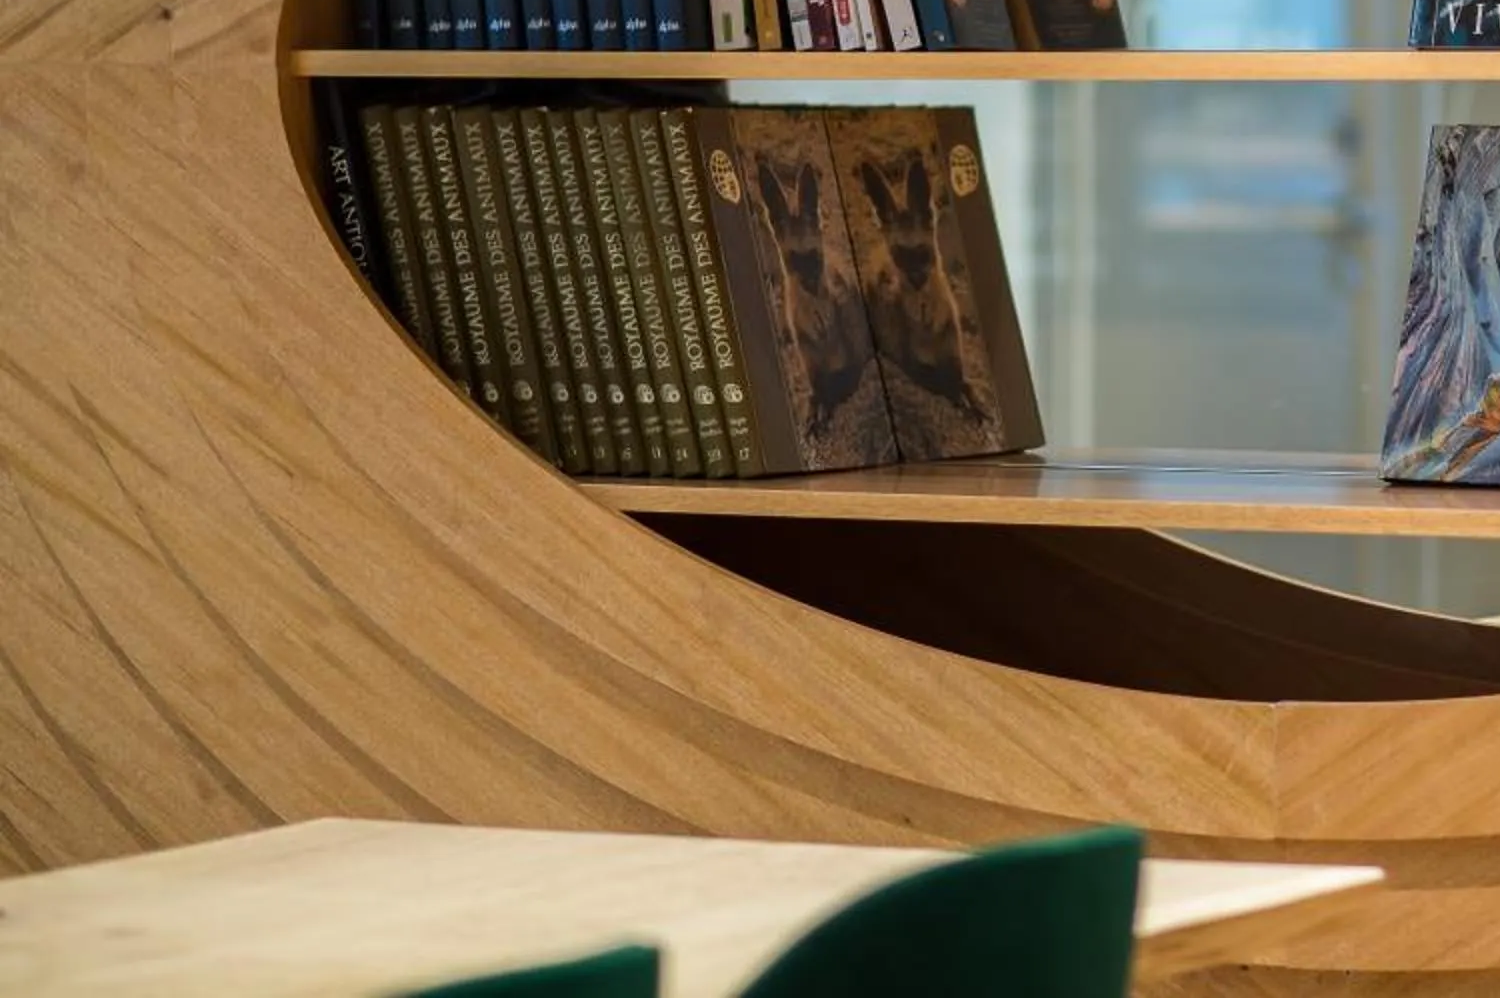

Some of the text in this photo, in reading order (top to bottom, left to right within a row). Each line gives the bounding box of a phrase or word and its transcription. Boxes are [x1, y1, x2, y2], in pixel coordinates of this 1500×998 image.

[328, 145, 351, 184] ART
[367, 122, 400, 222] ANIMAUX
[402, 122, 435, 222] ANIMAUX
[424, 228, 442, 265] DES
[431, 122, 491, 365] ROYAUME DES ANIMAUX
[465, 122, 525, 366] ROYAUME DES ANIMAUX
[498, 122, 560, 367] ROYAUME DES ANIMAUX
[528, 124, 588, 369] ROYAUME DES ANIMAUX
[552, 123, 615, 369] ROYAUME DES ANIMAUX
[583, 124, 646, 370] ROYAUME DES ANIMAUX
[607, 123, 671, 369] ROYAUME DES ANIMAUX
[640, 123, 705, 372] ROYAUME DES ANIMAUX
[670, 122, 734, 369] ROYAUME DES ANIMAUX
